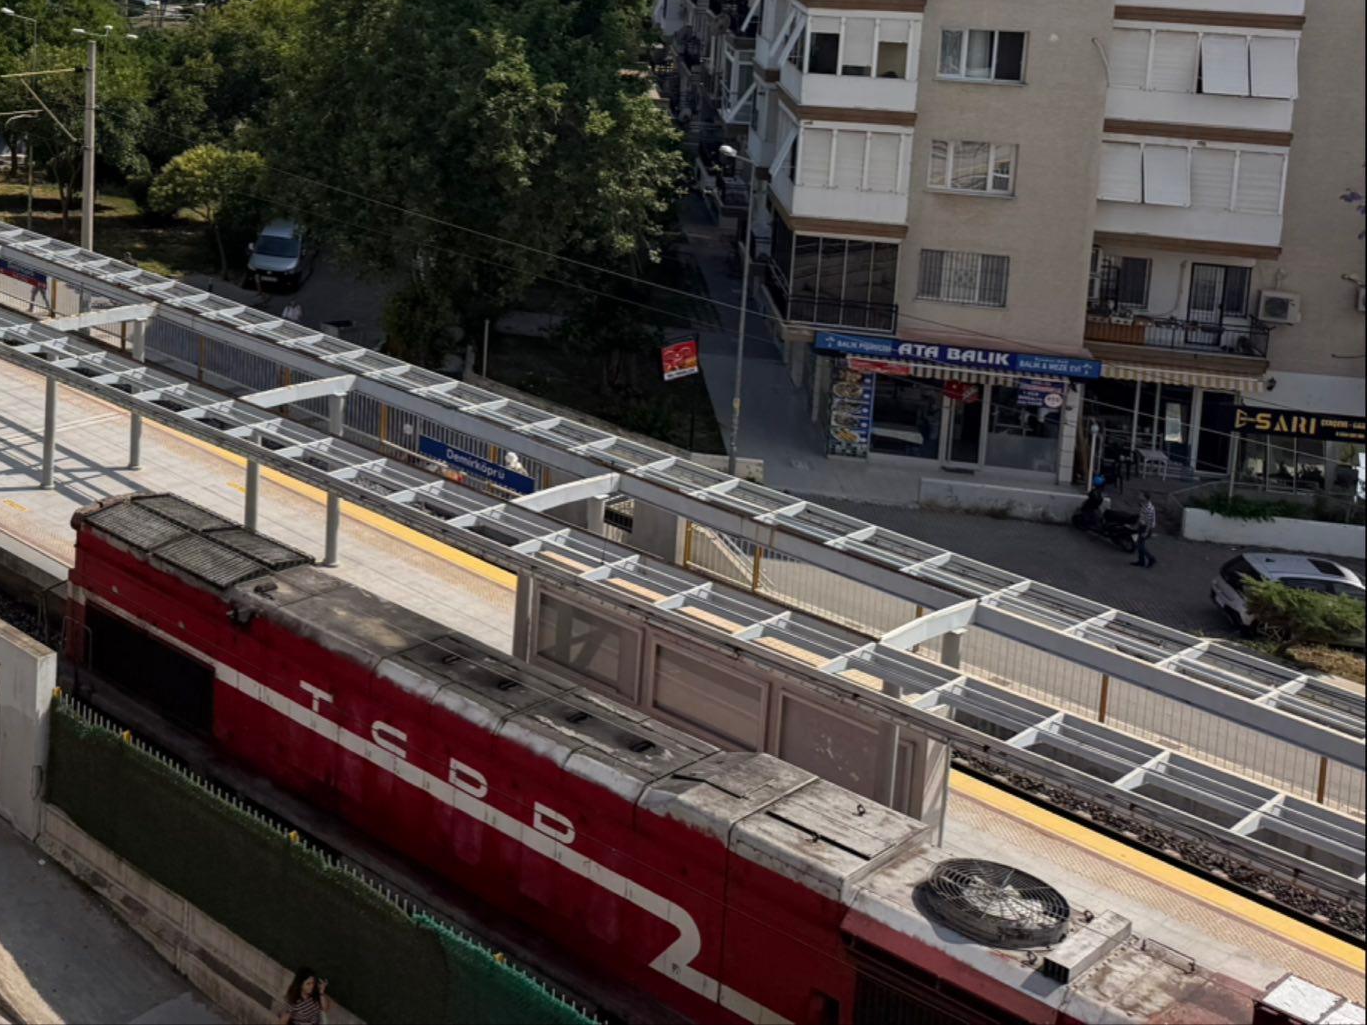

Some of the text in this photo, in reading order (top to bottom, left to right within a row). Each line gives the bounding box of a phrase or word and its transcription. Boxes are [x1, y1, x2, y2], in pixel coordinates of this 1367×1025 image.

[897, 342, 1011, 366] ATA BALIK
[445, 448, 506, 480] Demirköprü
[299, 679, 576, 845] TCDD
